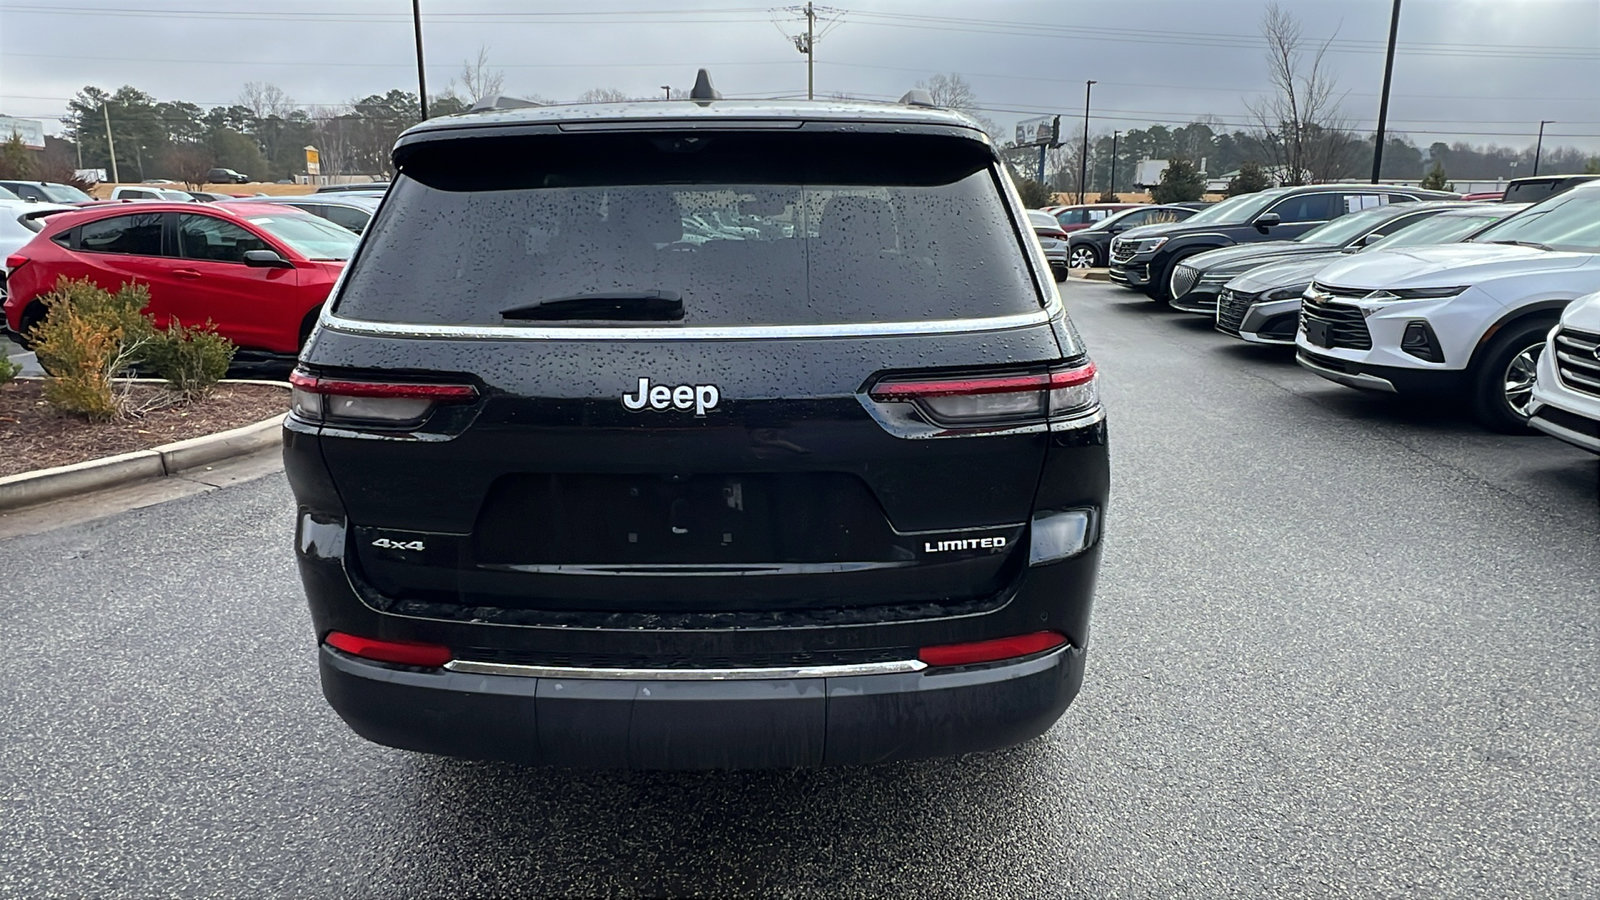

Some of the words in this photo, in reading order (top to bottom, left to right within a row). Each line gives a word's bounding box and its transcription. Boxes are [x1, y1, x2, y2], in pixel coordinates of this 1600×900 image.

[622, 377, 720, 416] Jeep
[371, 538, 426, 552] 4x4
[924, 536, 1007, 553] LIMITED
